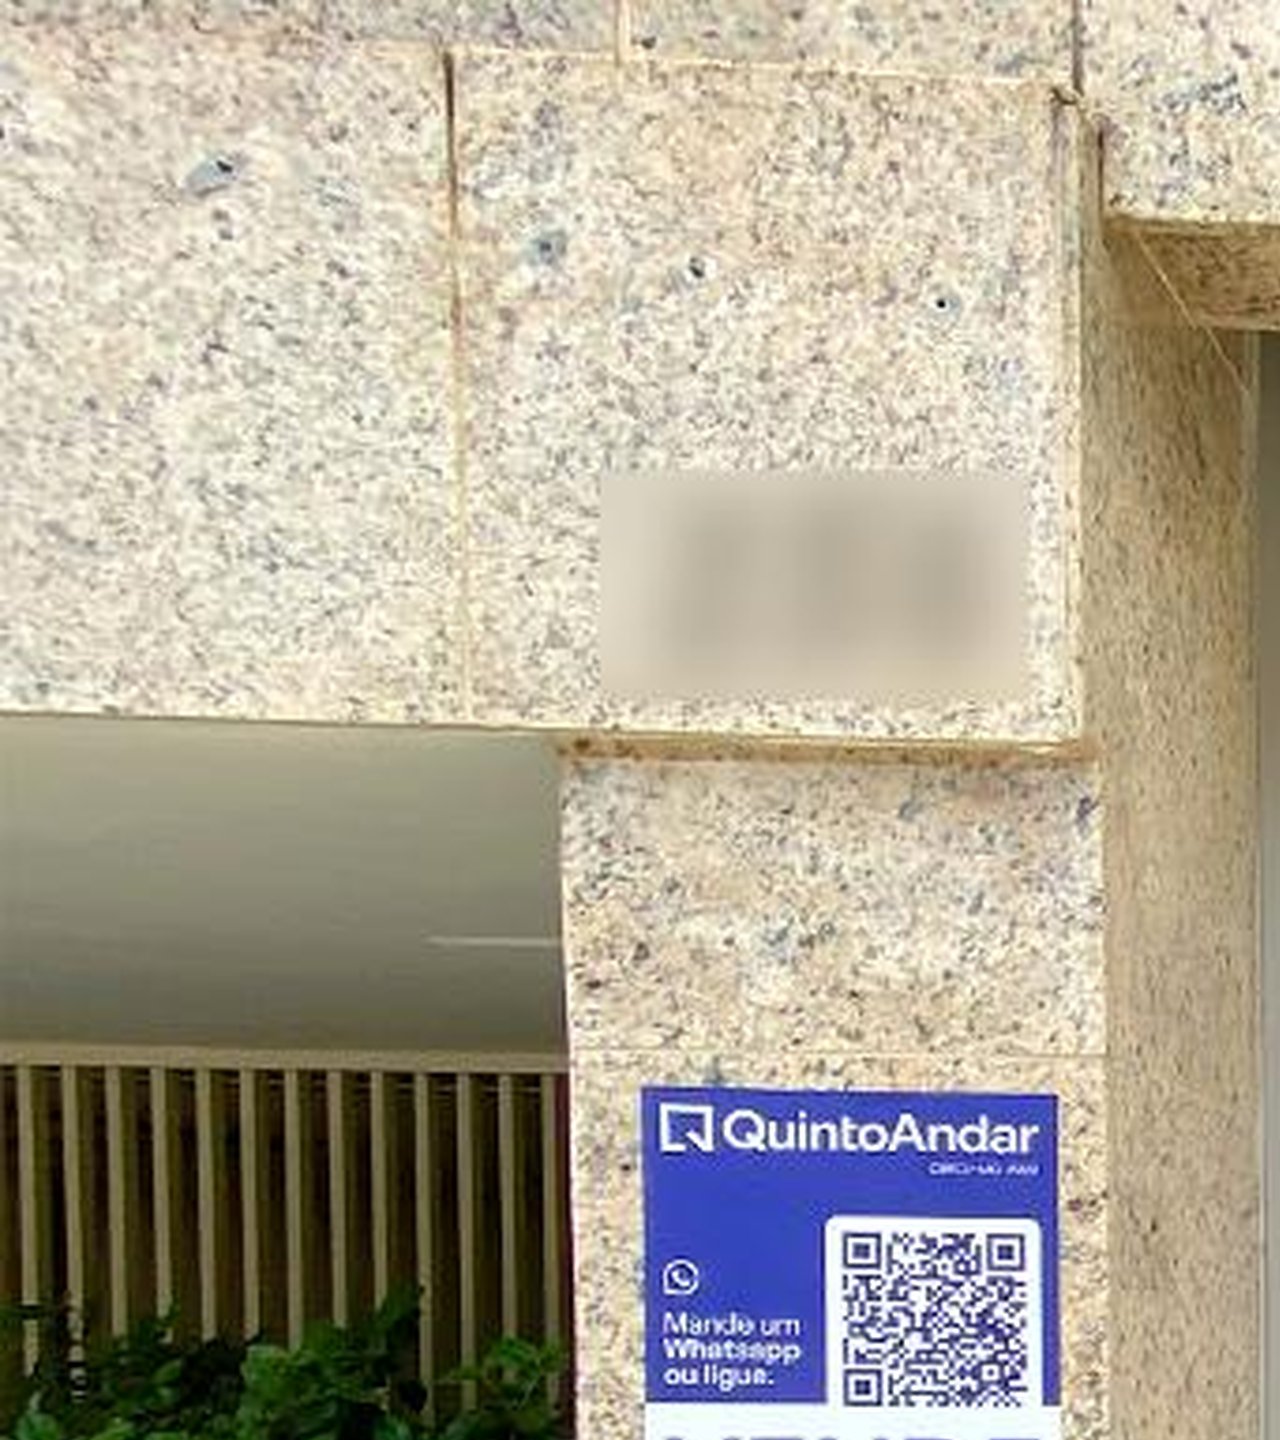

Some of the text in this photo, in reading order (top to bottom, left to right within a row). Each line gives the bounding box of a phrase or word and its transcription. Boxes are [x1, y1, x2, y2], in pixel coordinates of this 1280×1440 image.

[722, 1109, 1040, 1153] QuintoAndar
[662, 1311, 800, 1336] Mande um
[662, 1337, 802, 1366] Whatsapp
[663, 1363, 775, 1393] ou ligue.
